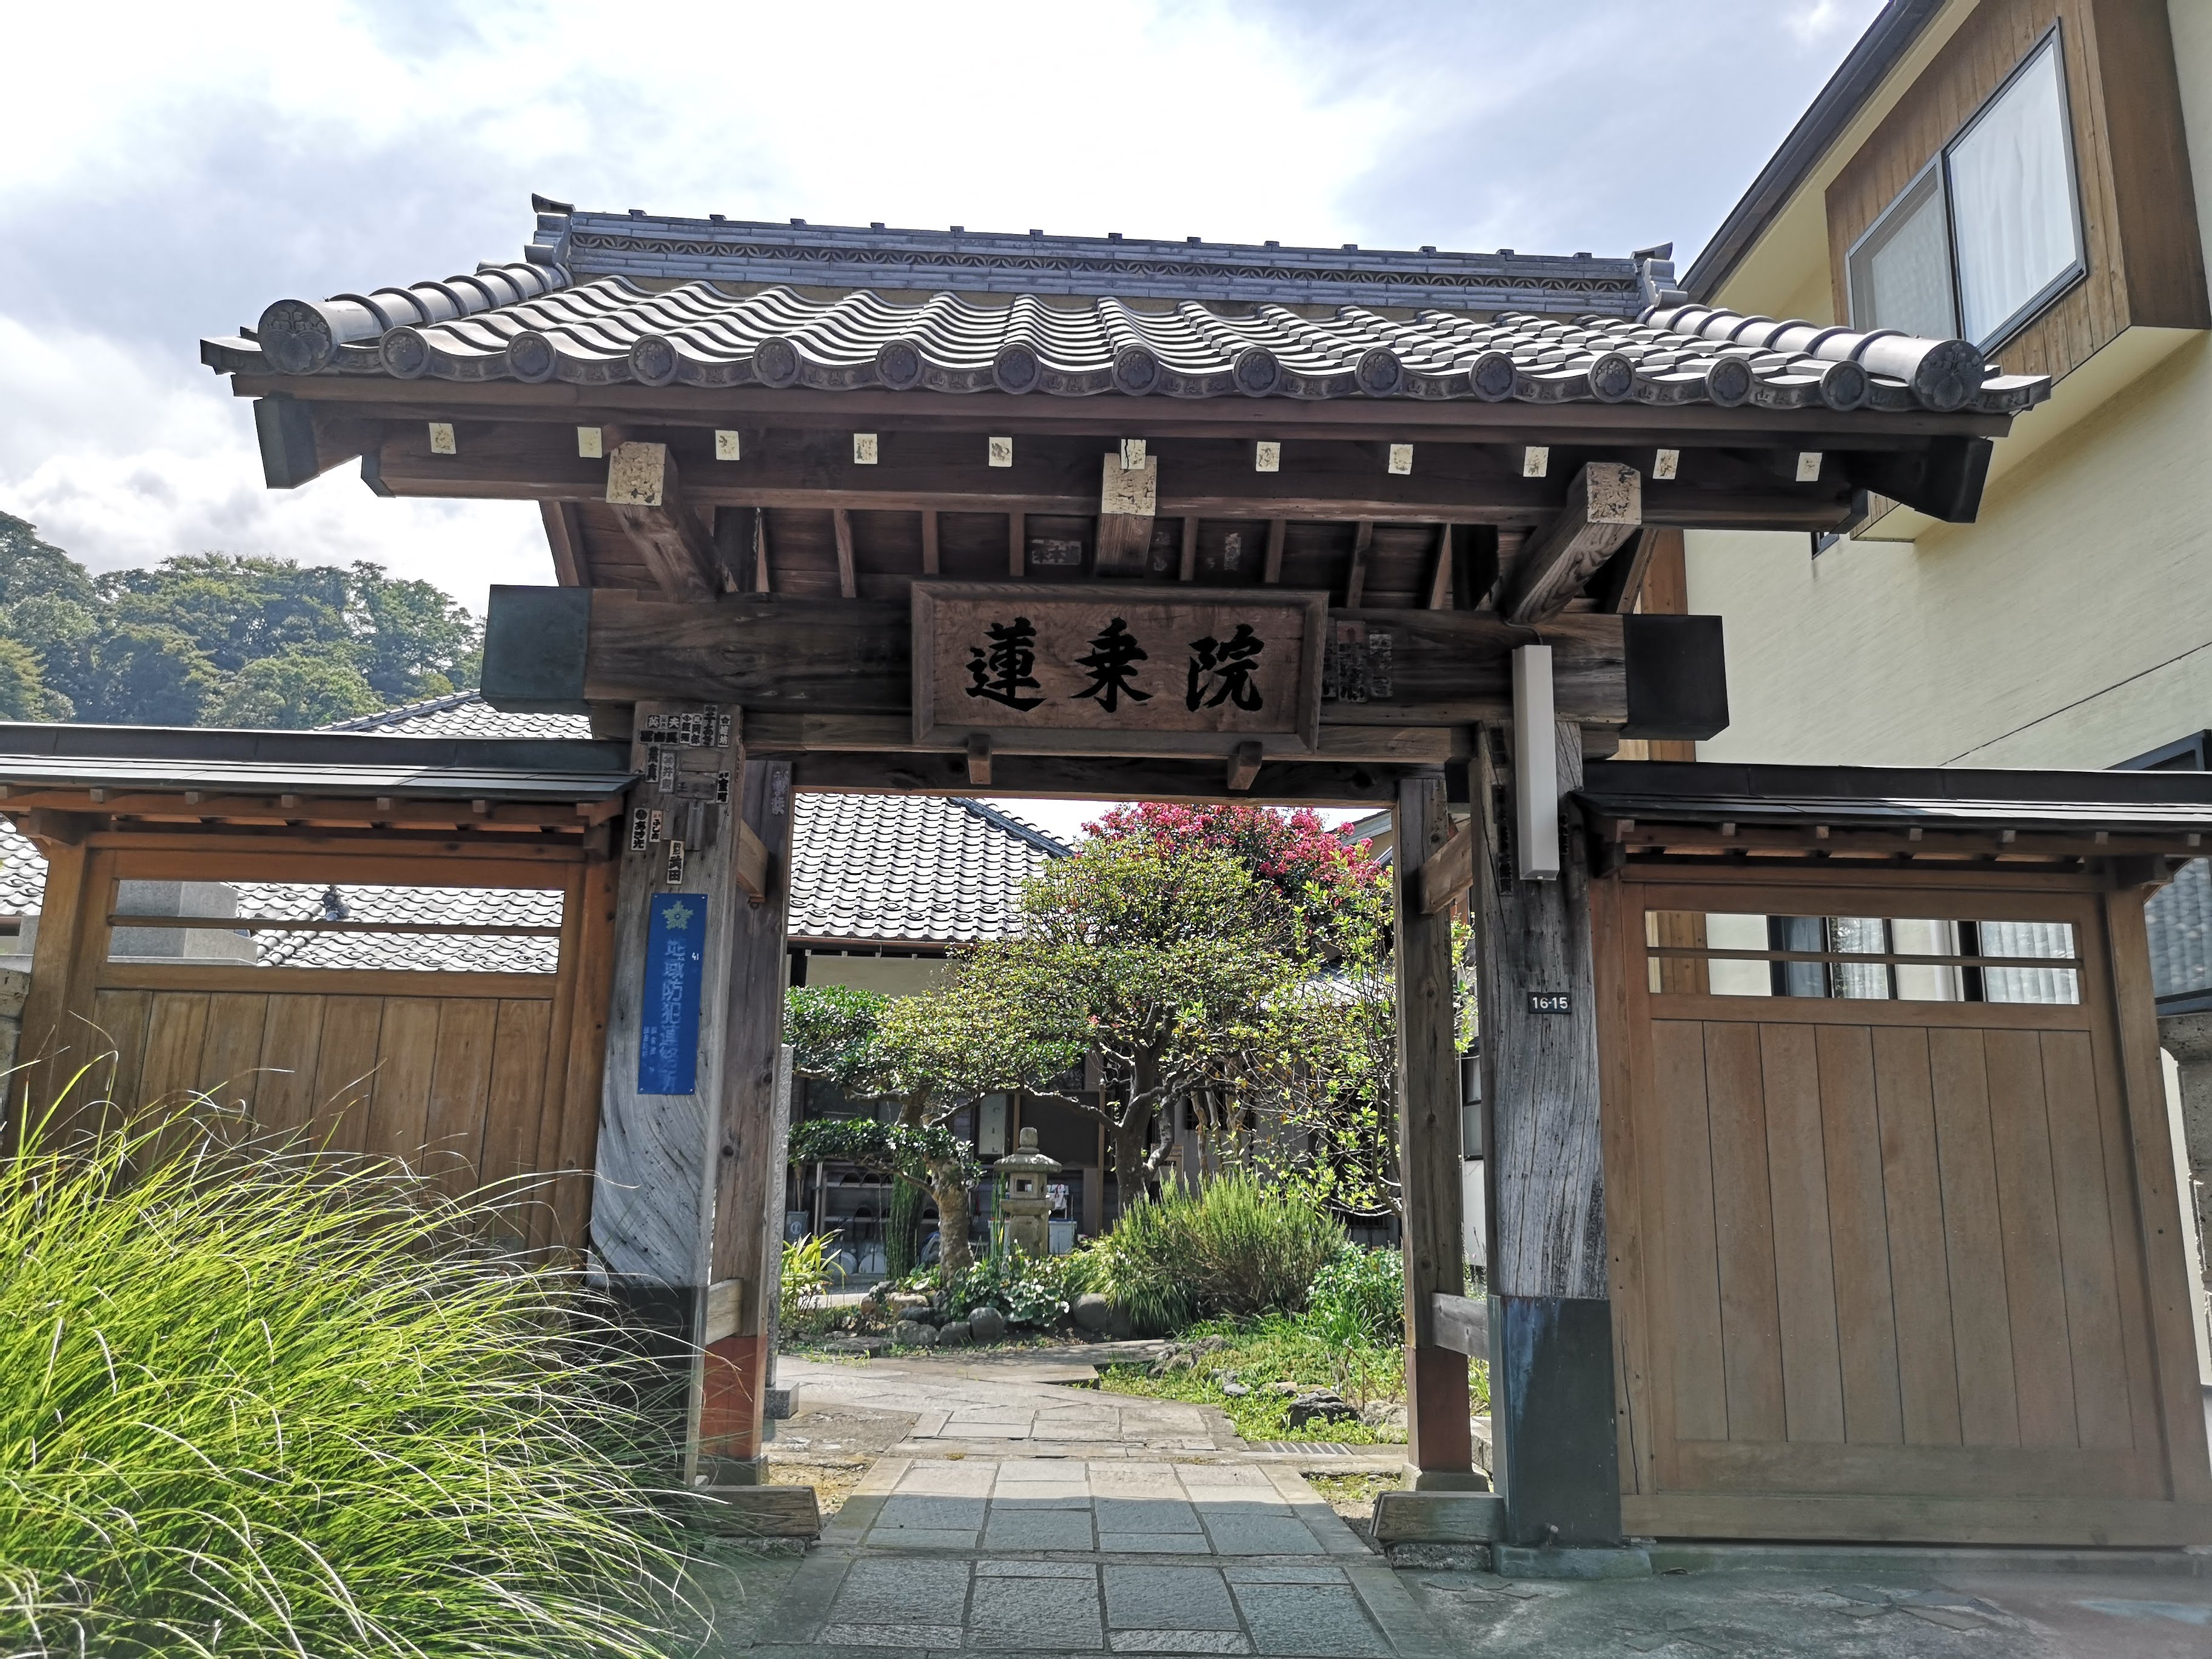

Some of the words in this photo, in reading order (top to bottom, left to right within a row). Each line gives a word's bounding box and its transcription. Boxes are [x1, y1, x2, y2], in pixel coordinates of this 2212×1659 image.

[965, 616, 1265, 713] 蓮乗院
[691, 952, 699, 960] 41
[1532, 997, 1568, 1009] 16-15
